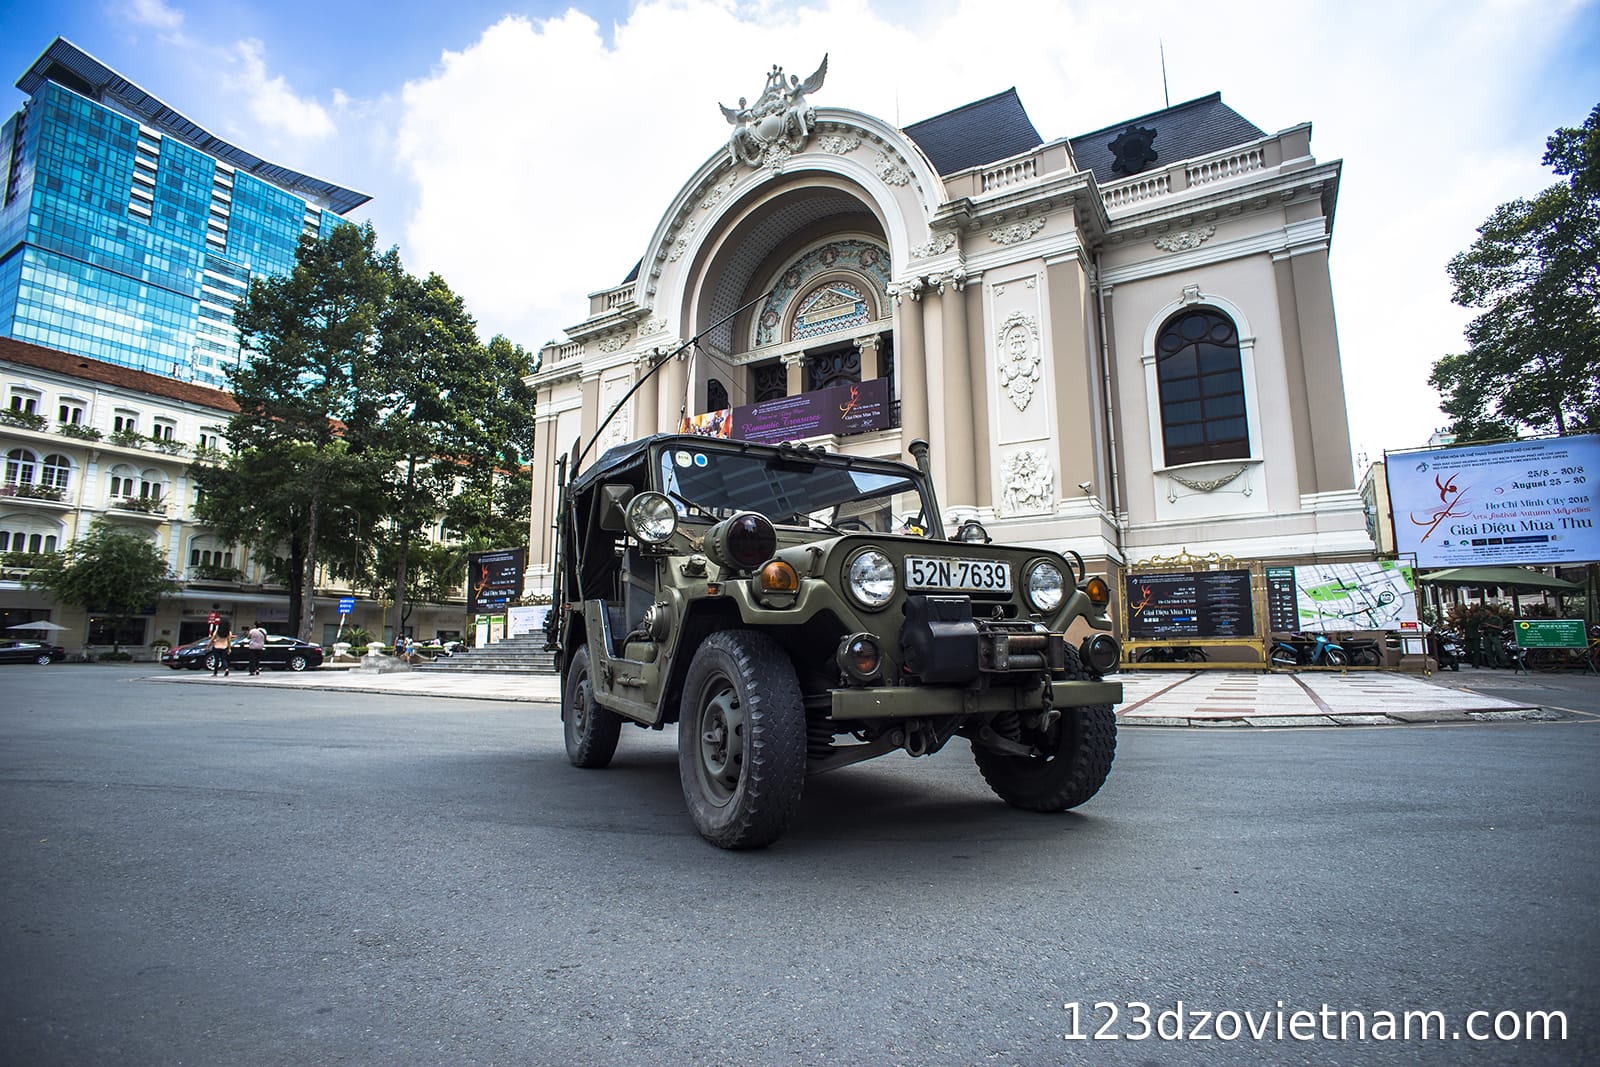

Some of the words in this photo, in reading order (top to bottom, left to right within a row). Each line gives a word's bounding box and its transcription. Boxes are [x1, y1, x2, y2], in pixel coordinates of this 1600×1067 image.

[1527, 469, 1550, 478] 25/8
[1561, 466, 1584, 475] 30/8
[1512, 480, 1547, 490] August
[1549, 478, 1562, 486] 25
[1573, 476, 1586, 484] 30
[1485, 502, 1500, 510] Ho
[1502, 501, 1518, 509] Chi
[1520, 498, 1544, 507] Minh
[1546, 497, 1566, 506] City
[1568, 496, 1590, 504] 2015
[1450, 524, 1478, 536] Giai
[1558, 517, 1593, 529] Thu
